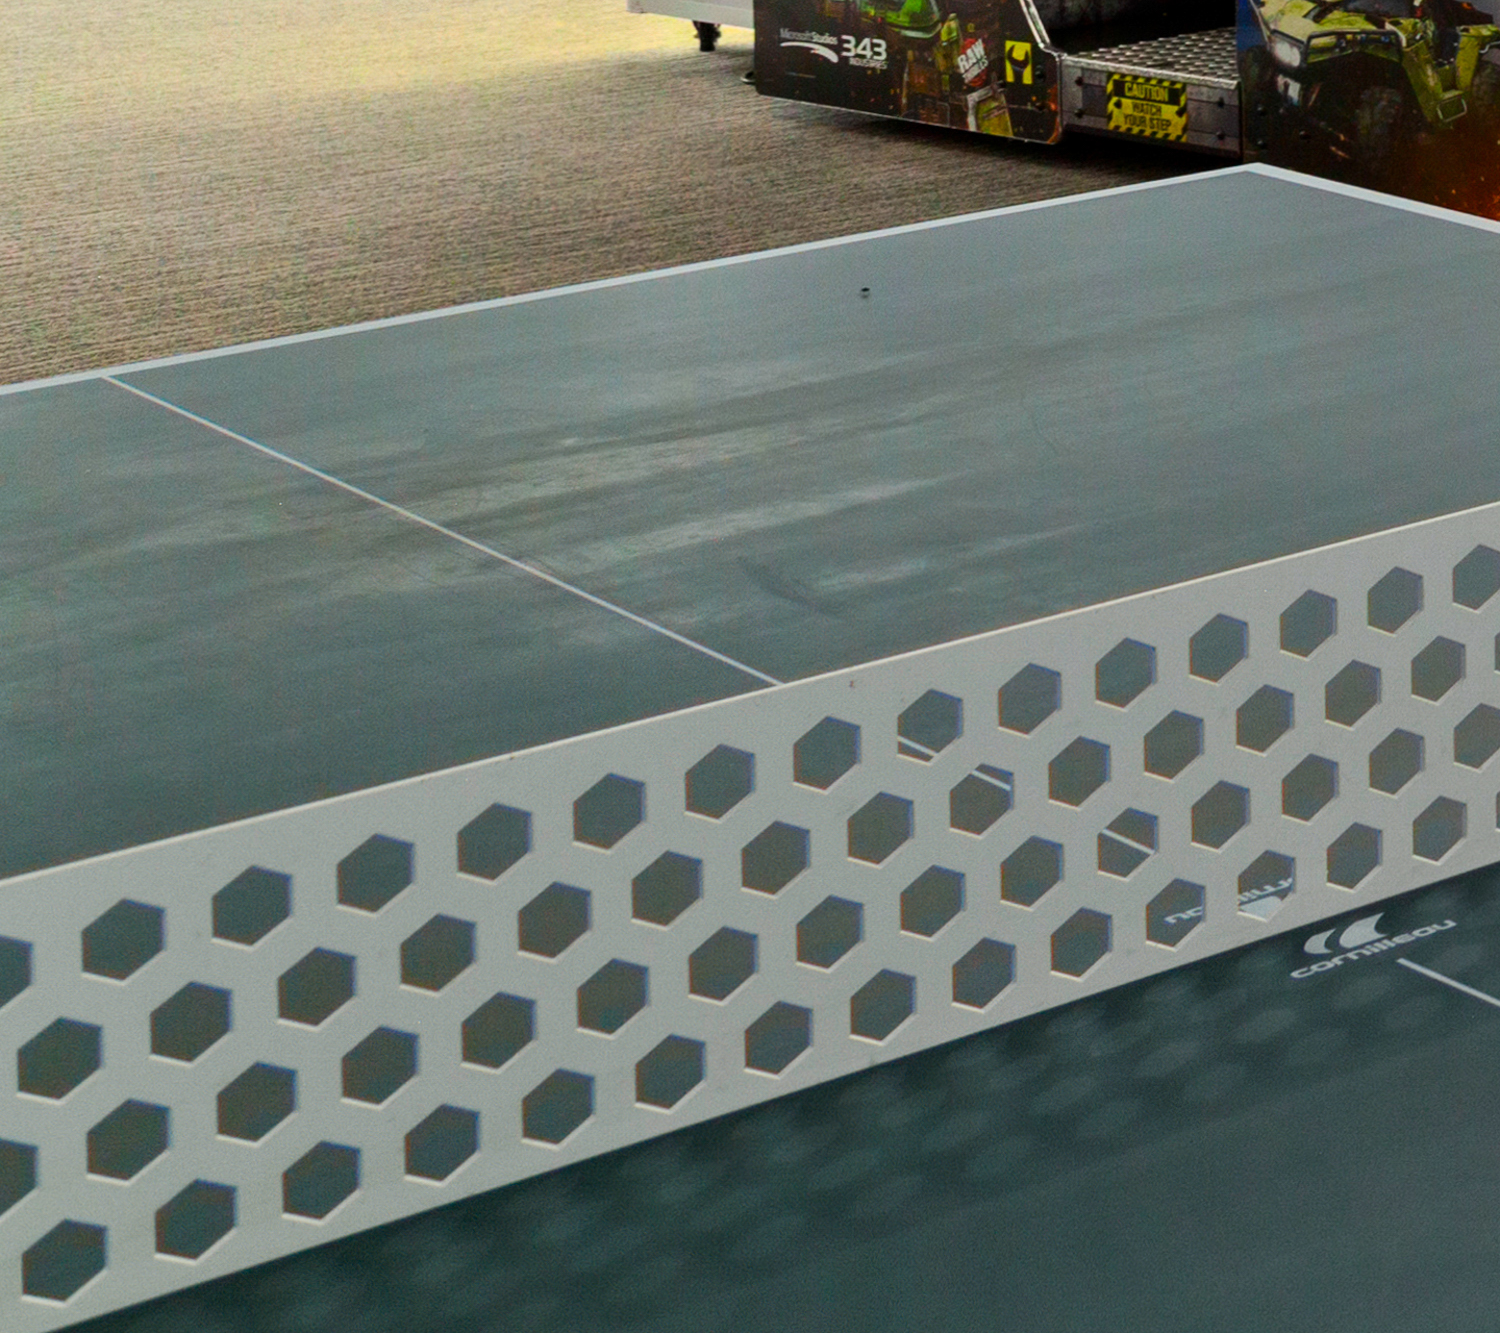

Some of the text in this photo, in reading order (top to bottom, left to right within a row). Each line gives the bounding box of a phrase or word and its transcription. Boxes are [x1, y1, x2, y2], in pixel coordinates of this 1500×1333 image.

[840, 35, 888, 61] 343
[957, 38, 986, 74] RAW
[1125, 82, 1169, 102] CAUTION
[1123, 113, 1172, 131] YOUR STEP
[1290, 919, 1457, 979] cornilleau
